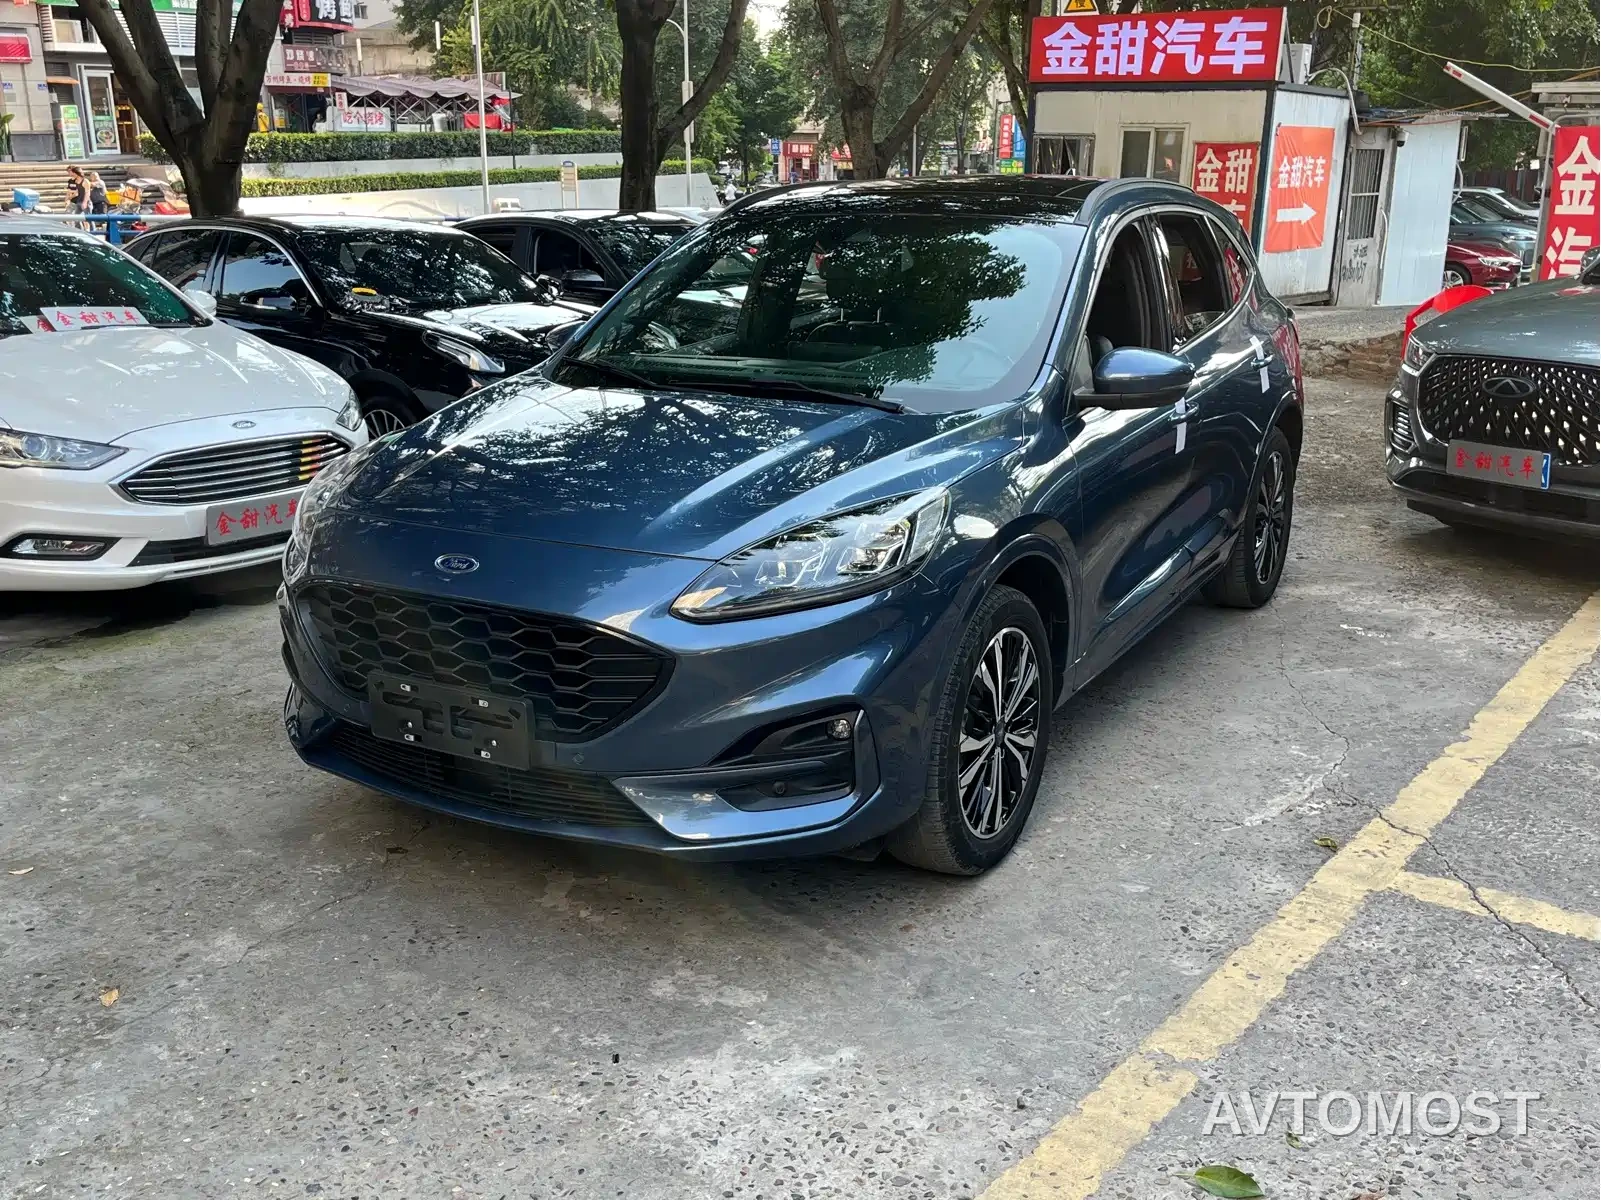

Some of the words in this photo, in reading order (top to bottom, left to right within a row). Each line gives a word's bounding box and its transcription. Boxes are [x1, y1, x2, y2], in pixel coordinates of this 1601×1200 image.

[1041, 16, 1268, 76] 金甜汽车
[1196, 147, 1252, 194] 金甜
[1277, 155, 1326, 189] 金甜汽车
